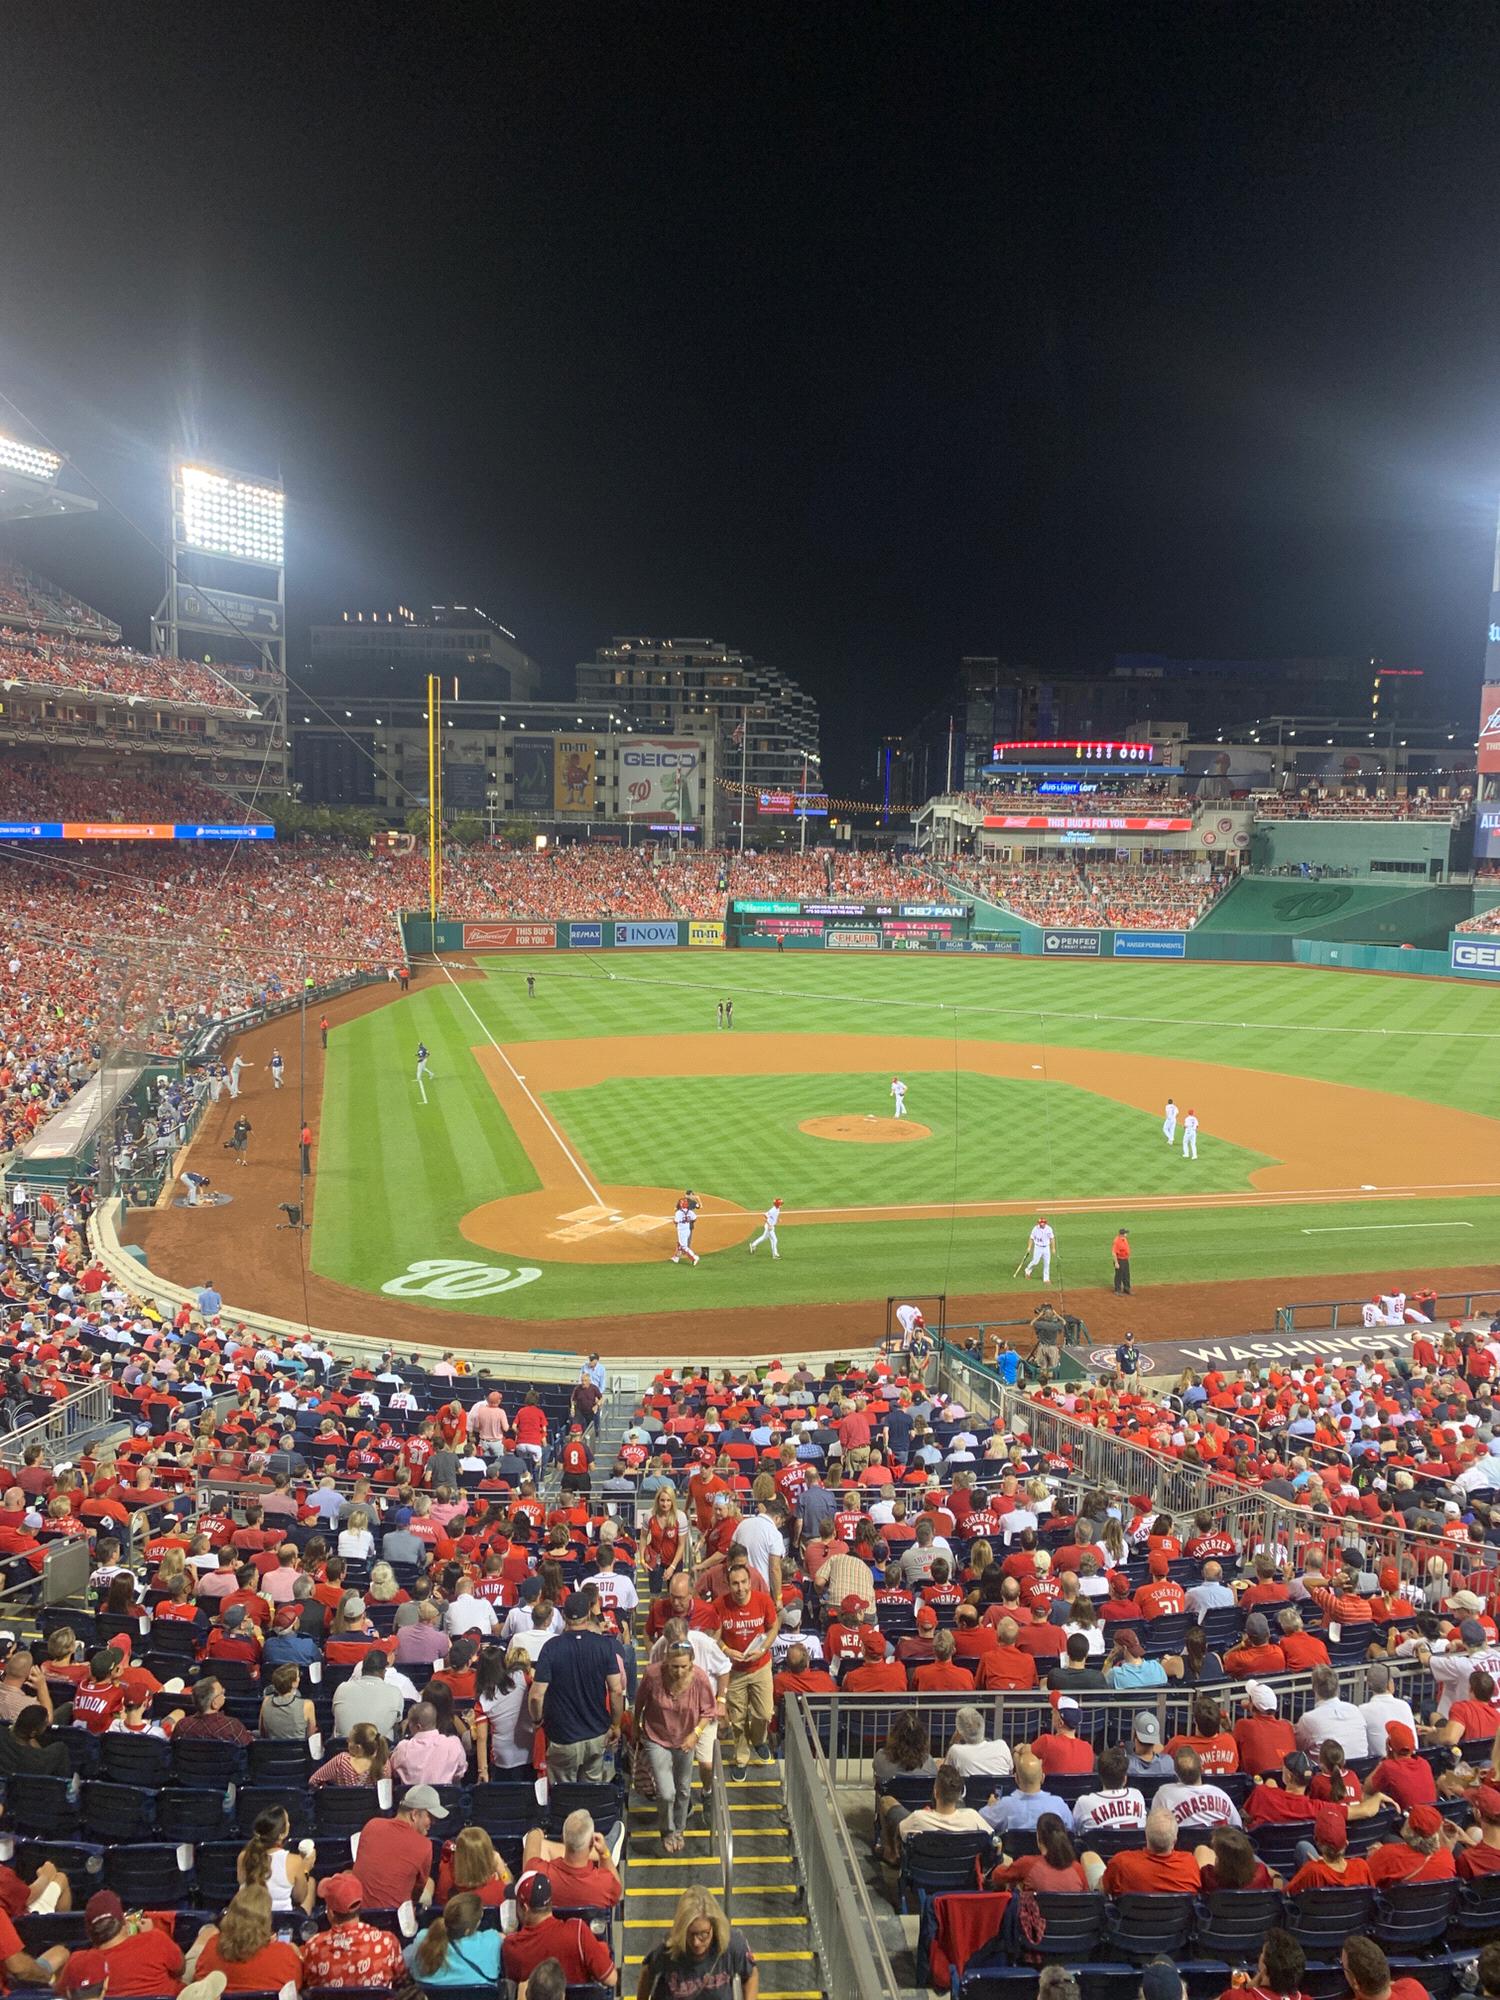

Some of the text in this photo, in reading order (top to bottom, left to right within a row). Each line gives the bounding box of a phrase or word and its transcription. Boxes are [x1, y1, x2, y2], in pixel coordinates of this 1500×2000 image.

[624, 752, 696, 768] GEICO
[935, 907, 963, 916] FAN
[516, 927, 554, 936] THIS BUD'S
[631, 927, 676, 940] INOVA
[516, 936, 547, 945] FOR YOU.
[1061, 937, 1097, 946] PENFED
[570, 1450, 579, 1465] 8
[962, 1513, 998, 1529] SCHERZER
[1193, 1541, 1232, 1559] SCHERZER
[1030, 1584, 1060, 1596] TURNER
[1151, 1588, 1182, 1601] SCHERZER
[840, 1634, 863, 1647] WER
[75, 1696, 107, 1714] ENDON
[1200, 1750, 1234, 1763] MMERMAN
[1091, 1800, 1143, 1825] KHADEMI
